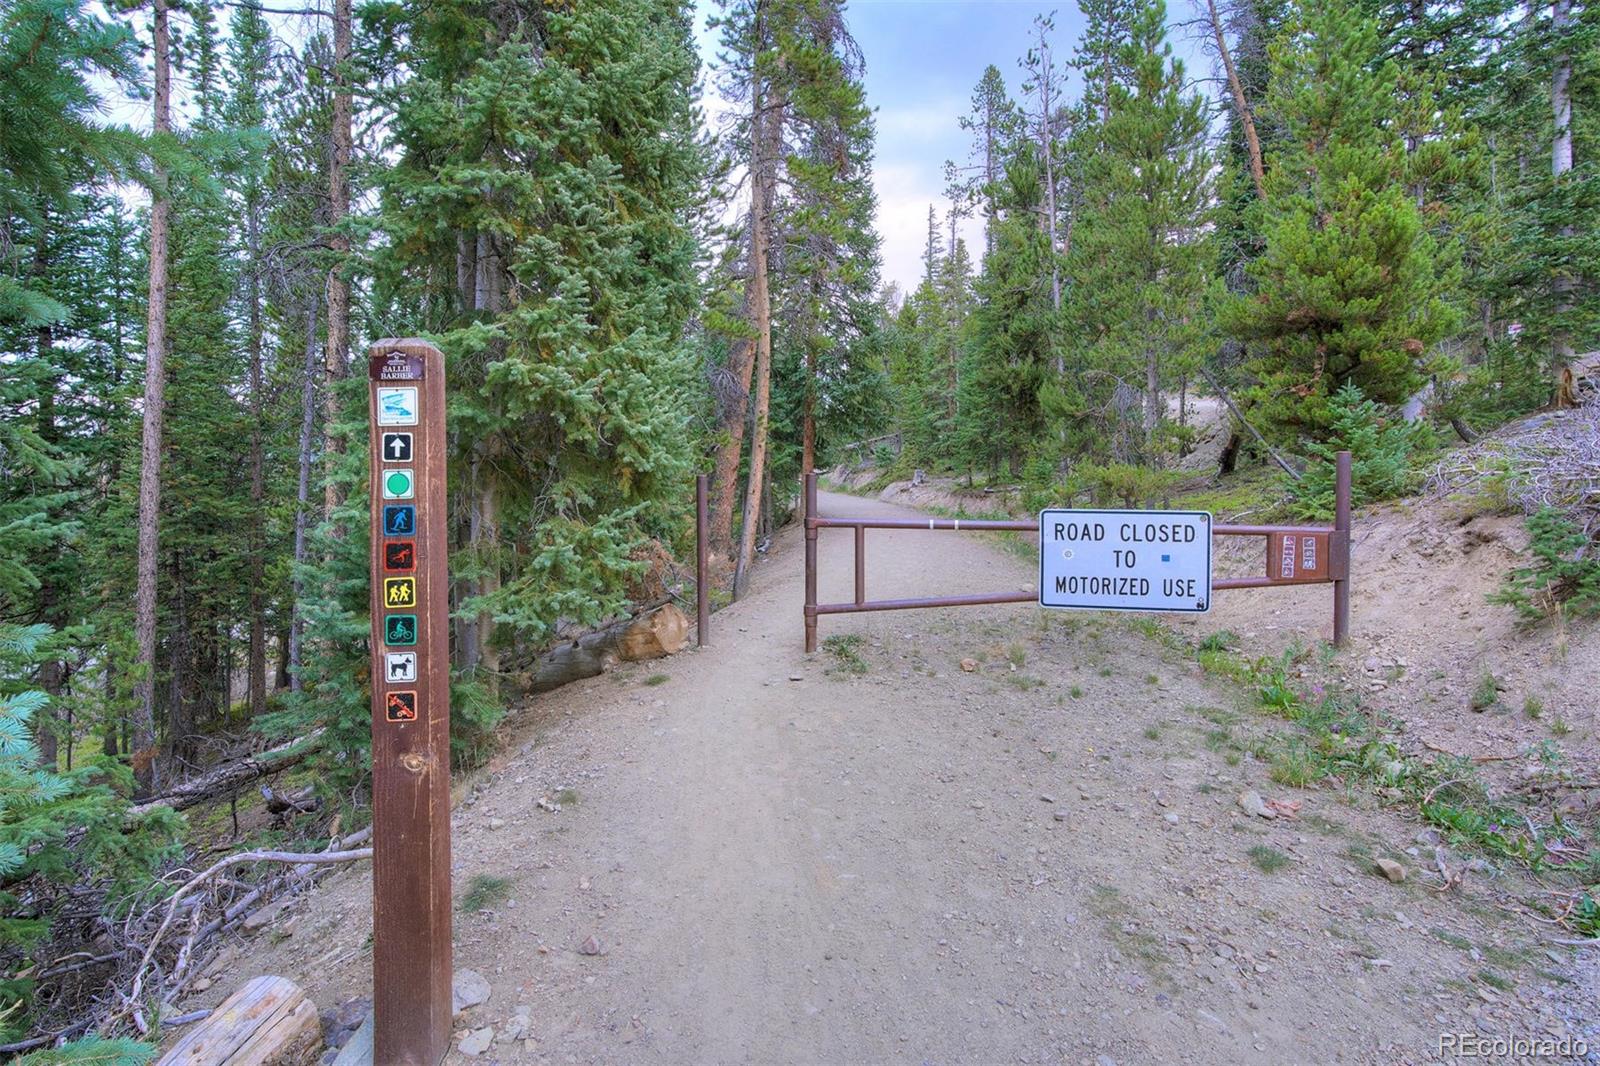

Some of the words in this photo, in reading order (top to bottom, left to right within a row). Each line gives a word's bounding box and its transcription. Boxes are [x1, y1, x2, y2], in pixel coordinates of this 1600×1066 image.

[1054, 523, 1105, 541] ROAD
[1120, 524, 1195, 543] CLOSED
[1113, 550, 1136, 569] TO
[1055, 576, 1150, 596] MOTORIZED
[1163, 579, 1196, 598] USE
